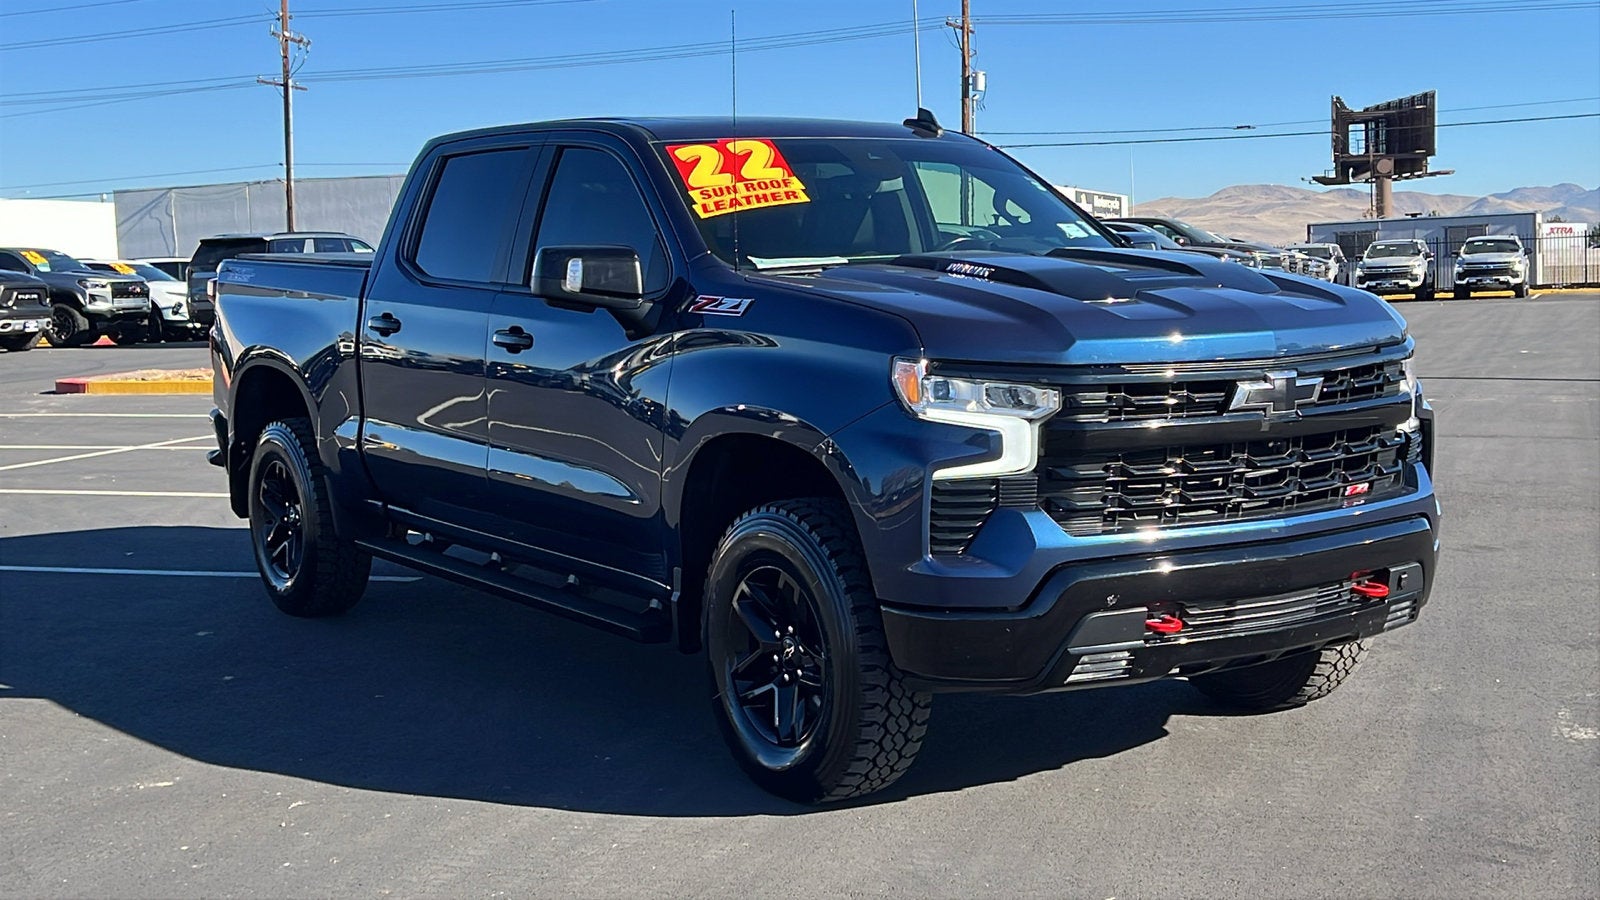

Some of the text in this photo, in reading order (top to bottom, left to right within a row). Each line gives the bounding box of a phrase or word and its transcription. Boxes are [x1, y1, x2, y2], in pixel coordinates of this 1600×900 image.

[674, 140, 786, 189] 22
[699, 178, 794, 200] SUN ROOF
[700, 190, 799, 214] LEATHER
[1546, 226, 1574, 236] XTRA
[688, 295, 755, 316] Z71
